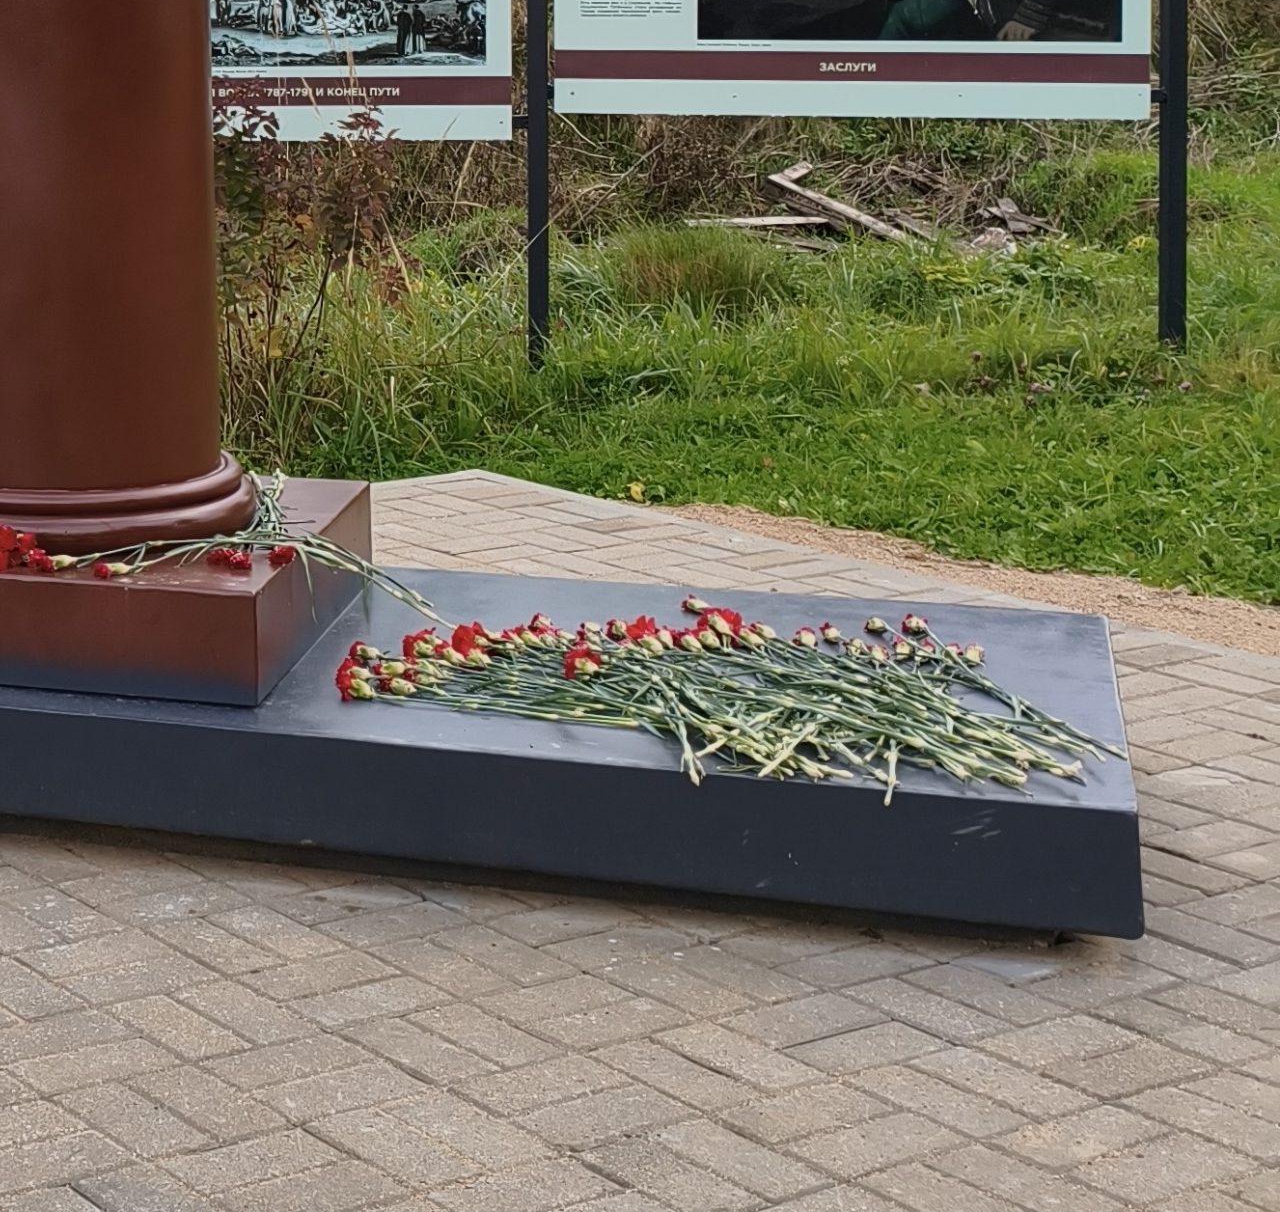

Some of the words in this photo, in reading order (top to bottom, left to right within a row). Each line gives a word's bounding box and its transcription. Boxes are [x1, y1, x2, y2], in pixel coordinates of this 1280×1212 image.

[819, 62, 877, 73] ЗАСЛУГИ
[263, 88, 313, 98] 787-179
[315, 88, 324, 97] И
[327, 88, 367, 99] КОНЕЦ
[370, 88, 400, 97] ПУТИ
